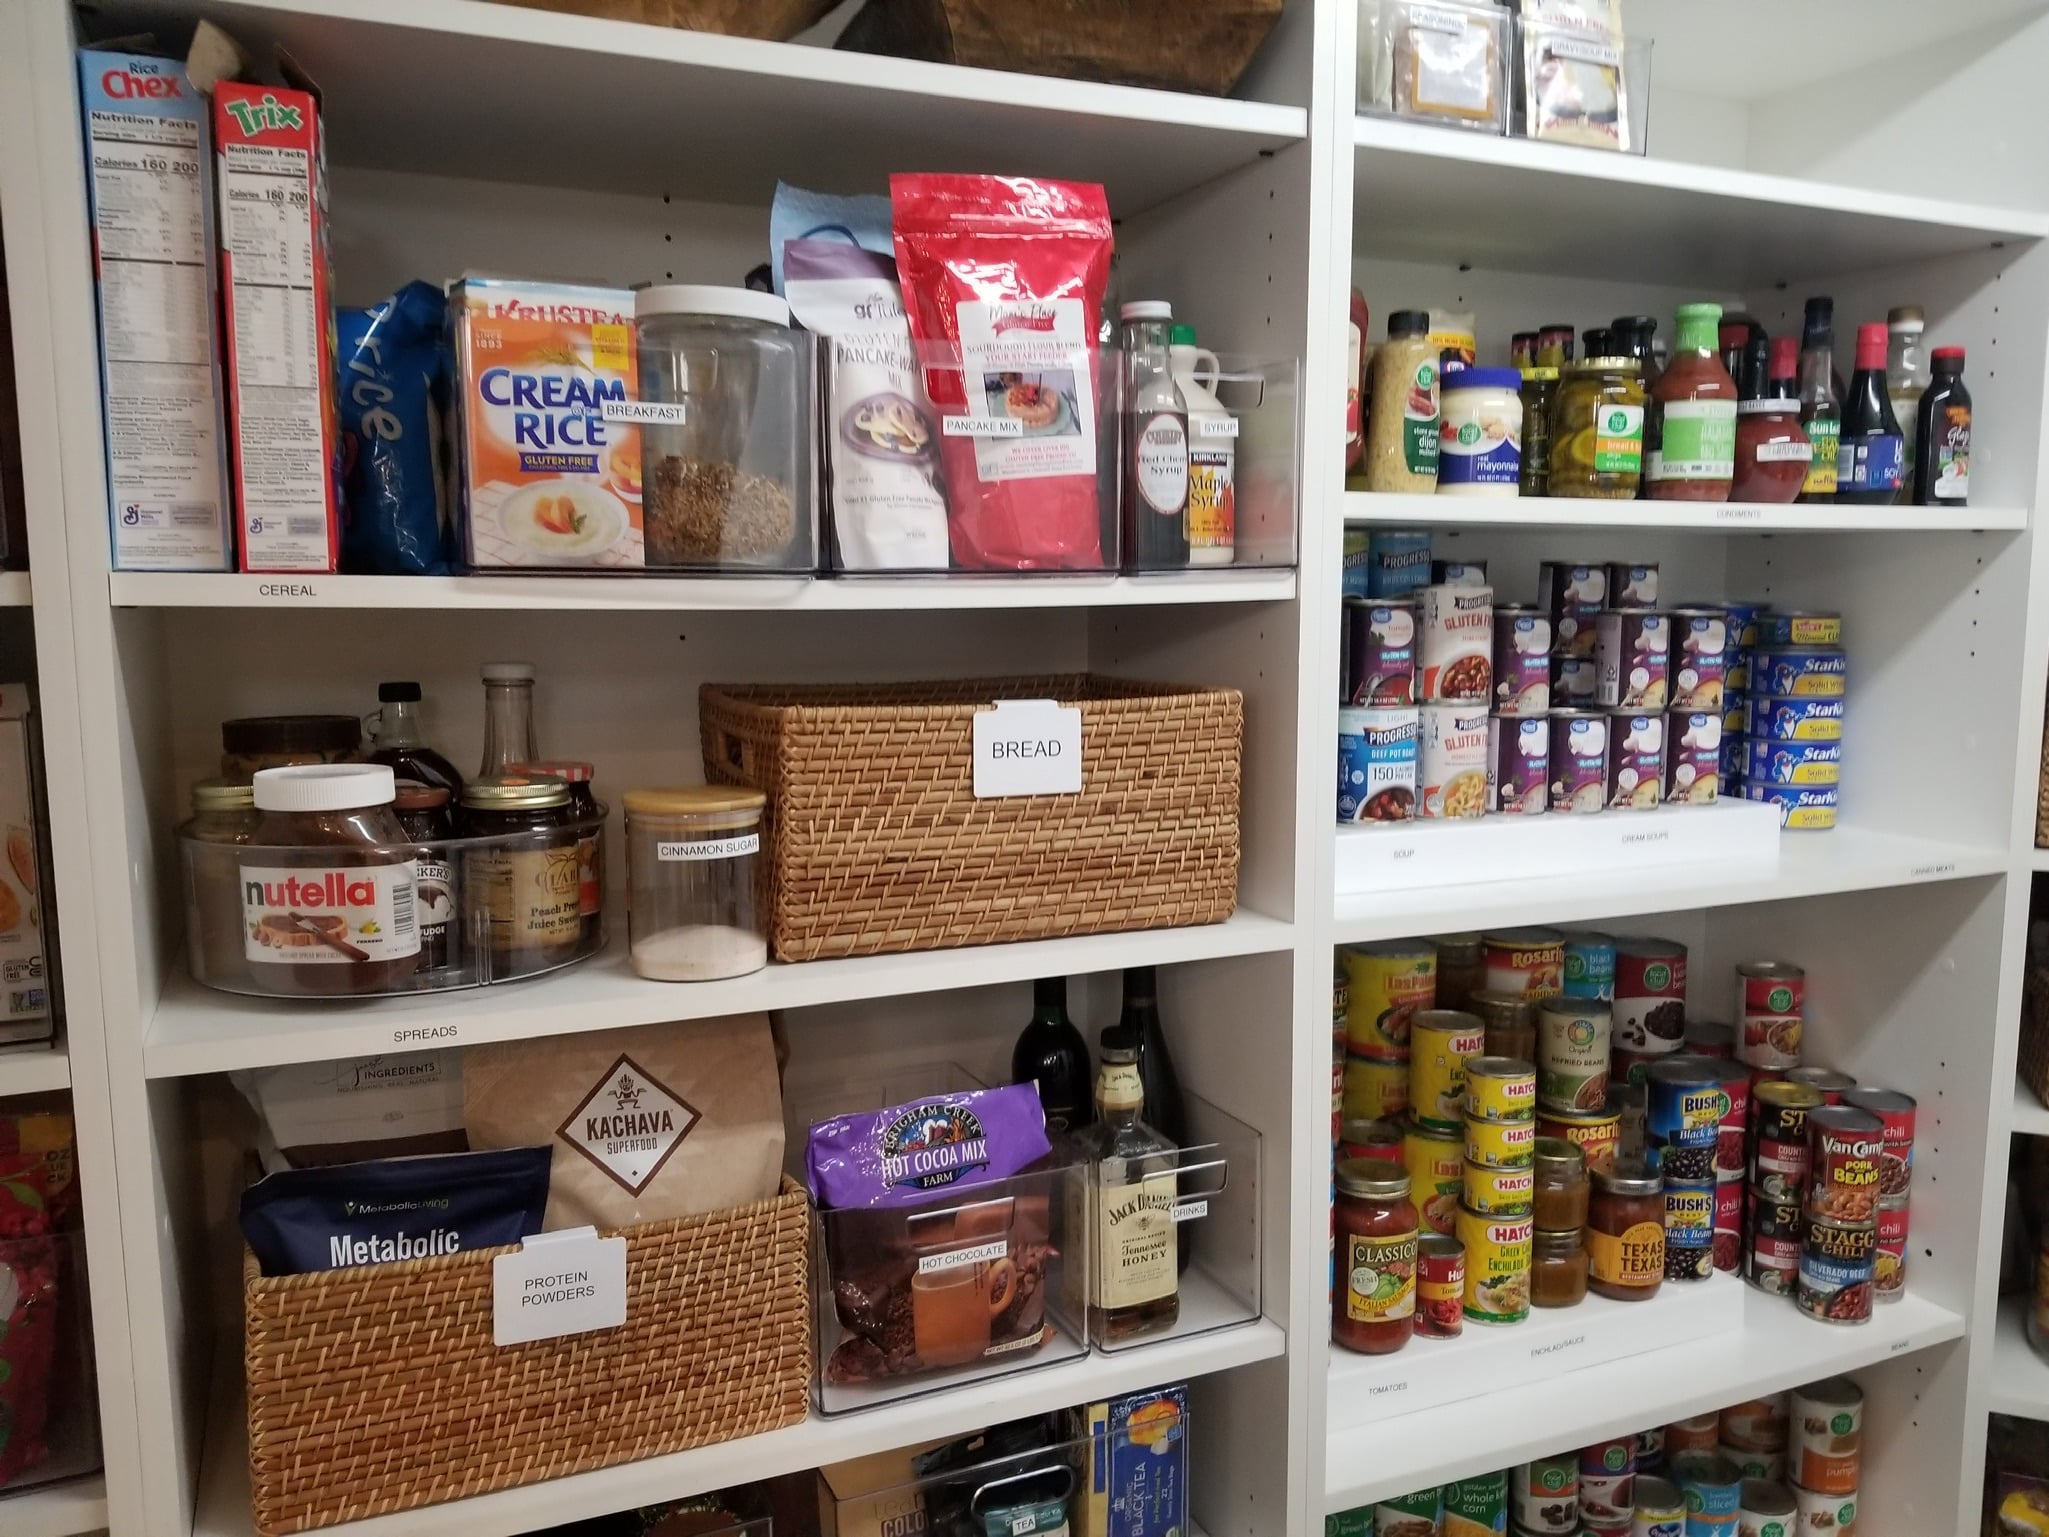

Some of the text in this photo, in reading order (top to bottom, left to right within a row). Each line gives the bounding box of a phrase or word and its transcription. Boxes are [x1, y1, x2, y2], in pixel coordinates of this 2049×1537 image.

[130, 62, 158, 74] Rice
[102, 69, 182, 99] Chex
[92, 112, 196, 129] Nutrition Facts
[225, 94, 304, 137] Trix
[228, 146, 306, 158] Nutrition Facts
[94, 156, 138, 168] Calories
[173, 162, 199, 174] 200
[229, 189, 260, 198] Calories
[289, 192, 308, 202] 200
[480, 369, 626, 410] CREAM
[606, 404, 682, 419] BREAKFAST
[515, 413, 607, 449] RICE
[946, 420, 1018, 432] PANCAKE MIX
[1204, 423, 1236, 434] SYRUP
[1419, 434, 1436, 449] dijon
[525, 456, 593, 466] GLUTEN FREE
[1194, 453, 1228, 462] KIRKLAND
[1150, 466, 1182, 480] Syrup
[1191, 476, 1229, 492] Maple
[1191, 492, 1228, 510] Syrup
[259, 584, 317, 597] CEREAL
[1445, 615, 1482, 631] GLUTEN
[1804, 658, 1846, 672] StarKi
[992, 740, 1062, 760] BREAD
[1445, 736, 1482, 751] GLUTEN
[1371, 749, 1401, 758] BEEF POT
[1373, 768, 1394, 782] 150
[1622, 834, 1646, 844] CREAM
[660, 839, 758, 856] CINNAMON SUGAR
[1394, 850, 1414, 860] SOUP
[1911, 864, 1955, 876] CANNED MEATS
[246, 872, 376, 907] nutella
[531, 906, 562, 917] Peach
[420, 926, 446, 936] UDGE
[528, 919, 556, 930] Juice
[1512, 945, 1564, 968] Rosarit
[6, 964, 29, 972] GLUTEN
[393, 1025, 458, 1043] SPREADS
[1551, 1056, 1582, 1066] REFRIED
[364, 1062, 436, 1080] INGREDIENTS
[586, 1110, 674, 1141] KA'CHAVA
[885, 1104, 982, 1150] BRIGHAM CREEK
[1567, 1122, 1621, 1143] Rosarit
[1884, 1127, 1904, 1137] chili
[1680, 1129, 1704, 1140] Black
[607, 1137, 658, 1155] SUPERFOOD
[882, 1140, 987, 1179] HOT COCOA MIX
[1846, 1161, 1872, 1170] PORK
[924, 1172, 953, 1187] FARM
[1834, 1167, 1879, 1184] BEANS
[1666, 1195, 1711, 1211] BUSH'S
[1108, 1200, 1136, 1226] JACK
[1173, 1204, 1206, 1218] DRINKS
[1811, 1225, 1874, 1247] STAGG
[1880, 1224, 1900, 1234] chili
[329, 1228, 460, 1268] Metabolic
[1122, 1240, 1166, 1256] Tennessee
[1356, 1241, 1417, 1262] CLASSICO
[1622, 1241, 1662, 1256] TEXAS
[1822, 1244, 1864, 1257] CHILI
[922, 1245, 1005, 1270] HOT CHOCOLATE
[1122, 1250, 1167, 1267] HONEY
[1621, 1256, 1662, 1273] TEXAS
[1809, 1261, 1865, 1279] SILVERADO BEEF
[524, 1270, 588, 1290] PROTEIN
[521, 1285, 595, 1307] POWDERS
[1359, 1296, 1387, 1309] ITALIAN
[1368, 1382, 1408, 1396] TOMATOES
[1131, 1462, 1146, 1537] BLACK TEA
[1408, 1490, 1435, 1503] green
[1464, 1492, 1494, 1503] whole
[1463, 1504, 1486, 1513] corn
[1015, 1519, 1034, 1531] TEA
